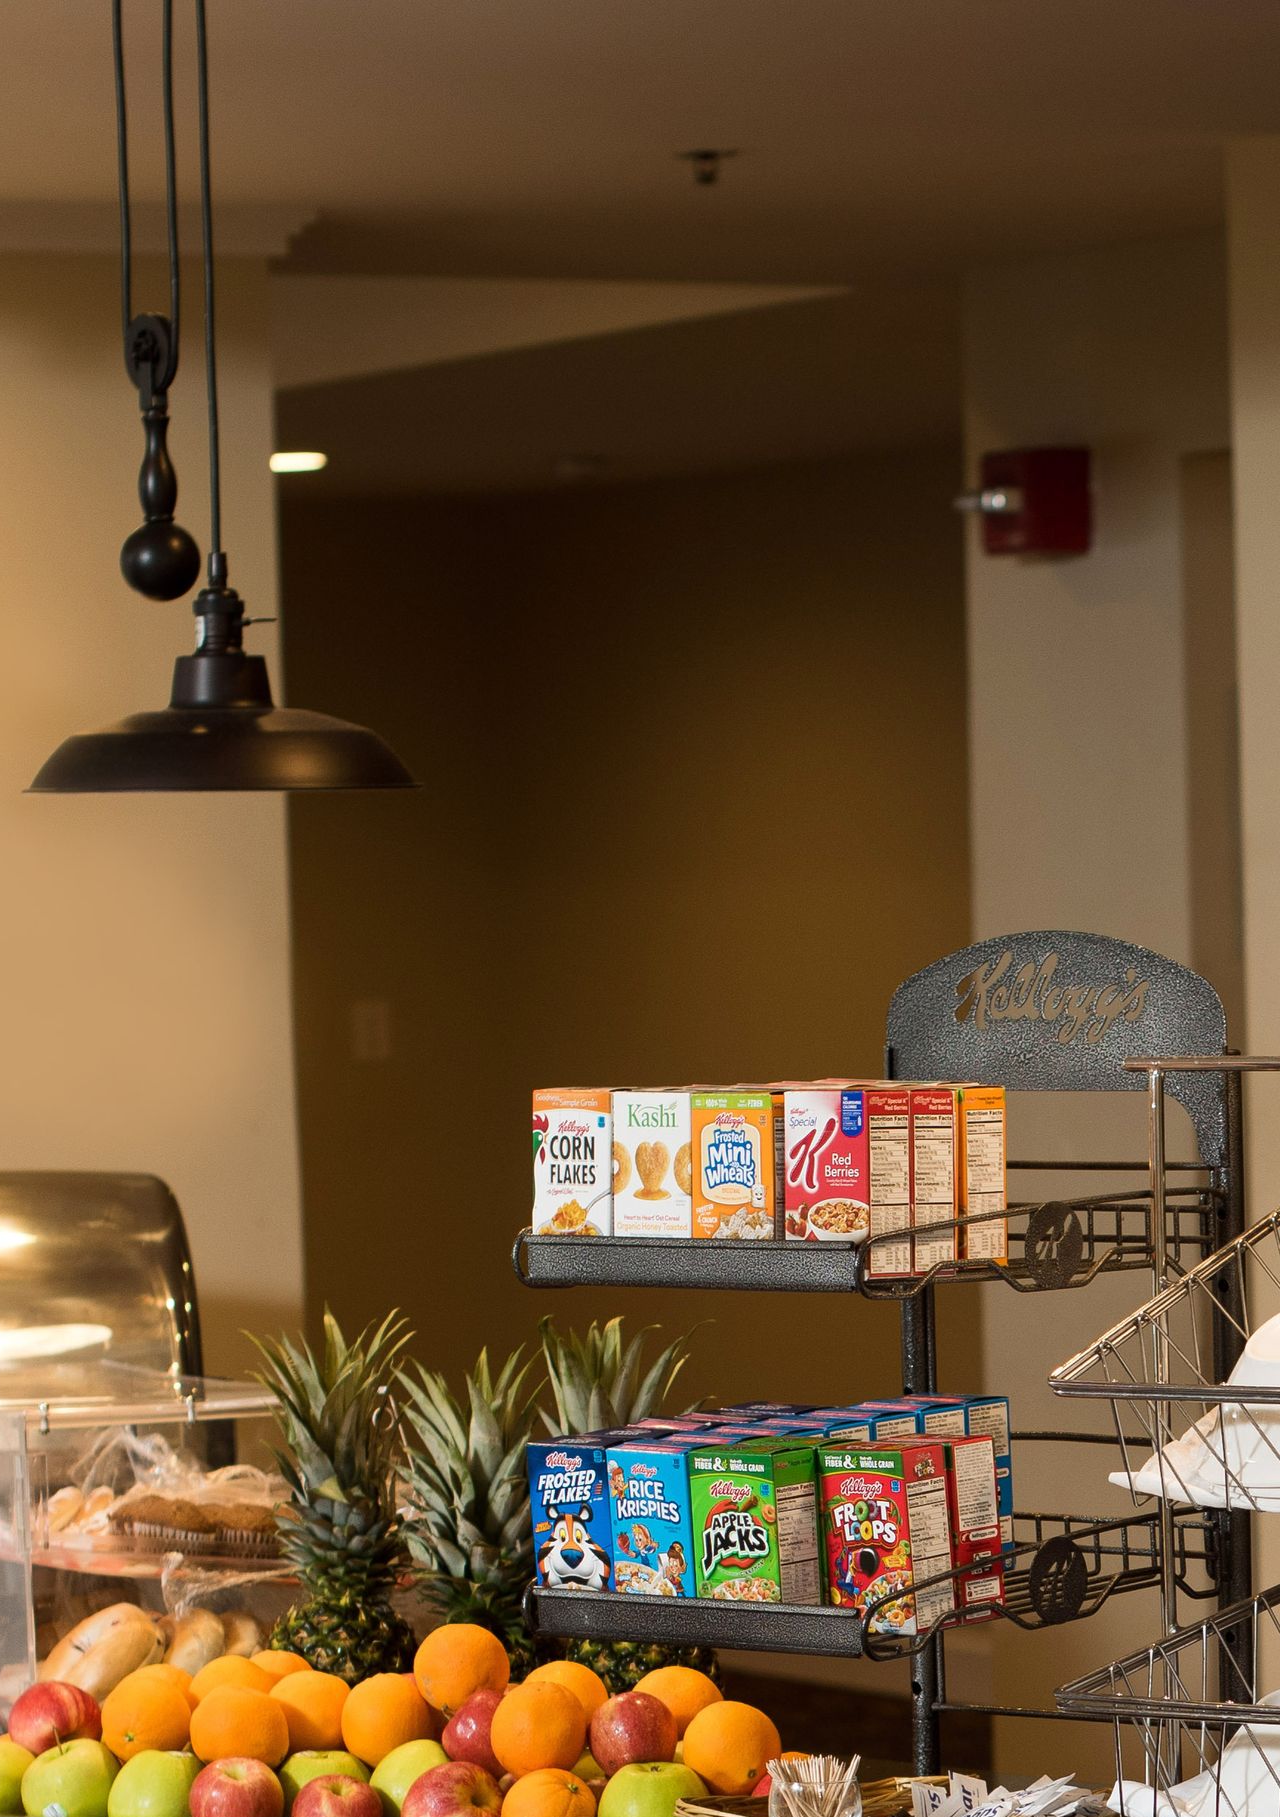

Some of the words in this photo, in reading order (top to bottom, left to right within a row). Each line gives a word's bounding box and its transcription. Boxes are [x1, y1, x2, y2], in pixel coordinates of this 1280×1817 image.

[954, 950, 1149, 1044] Kellogg's
[627, 1102, 677, 1127] Kashi
[715, 1112, 745, 1128] Kellogg's
[789, 1116, 817, 1129] Special
[558, 1120, 590, 1137] Kellogg's
[715, 1130, 744, 1144] Frosted
[550, 1135, 595, 1160] CORN
[709, 1142, 752, 1168] Mini
[789, 1117, 836, 1189] K
[831, 1153, 852, 1165] Red
[550, 1164, 596, 1185] FLAKES
[706, 1163, 754, 1188] Wheats
[825, 1165, 860, 1177] Berries
[546, 1452, 582, 1471] Kellogg's
[630, 1464, 658, 1478] Kellogg's
[537, 1469, 596, 1490] FROSTED
[841, 1477, 882, 1499] Kellogg's
[542, 1485, 592, 1506] FLAKES
[629, 1480, 665, 1501] RICE
[710, 1480, 751, 1501] Kellogg's
[617, 1500, 680, 1523] KRISPIES
[833, 1500, 890, 1527] FROOT
[712, 1514, 751, 1531] APPLE
[844, 1520, 897, 1543] LOOPS
[704, 1526, 767, 1571] JACKS
